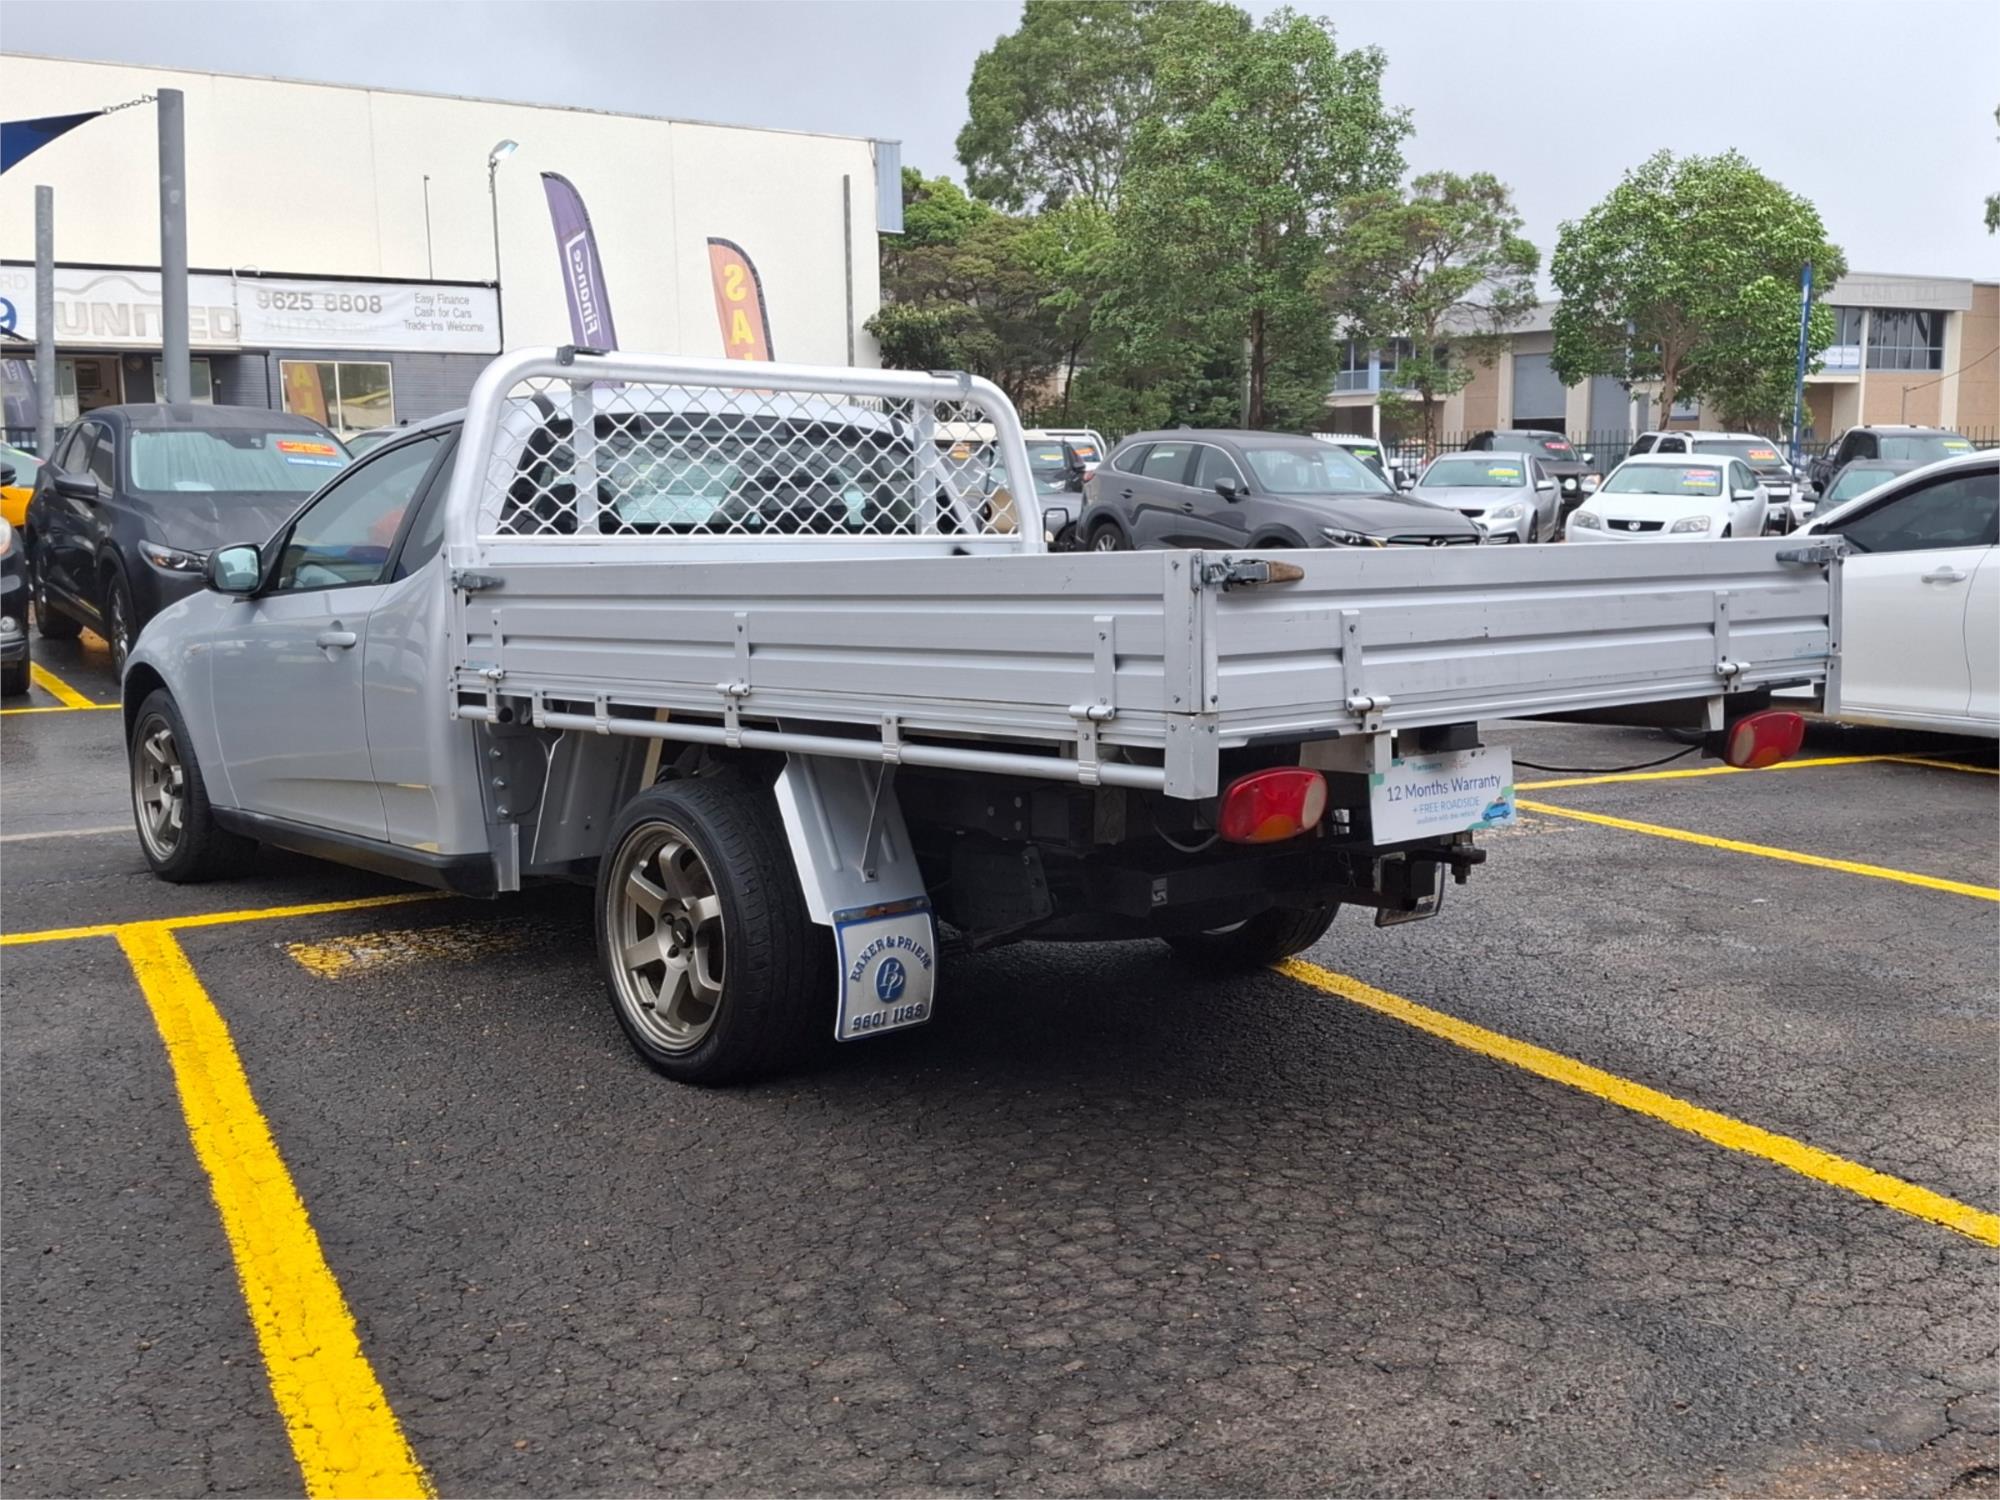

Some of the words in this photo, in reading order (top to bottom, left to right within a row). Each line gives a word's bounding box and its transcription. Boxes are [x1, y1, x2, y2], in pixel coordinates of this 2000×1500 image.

[256, 288, 314, 311] 9625
[324, 292, 383, 314] 8808
[414, 292, 434, 305] Easy
[437, 293, 470, 305] Finance
[414, 306, 436, 318] Cash
[438, 307, 450, 318] for
[452, 307, 473, 319] Cars
[447, 320, 484, 333] Welcome
[1387, 785, 1402, 802] 12
[1405, 779, 1448, 800] Months
[1451, 774, 1501, 793] Warranty
[1420, 802, 1440, 814] FREE
[1441, 796, 1480, 811] ROADSIDE
[850, 938, 885, 982] BAKER
[897, 935, 932, 970] PRIEM
[893, 1002, 924, 1024] 1188
